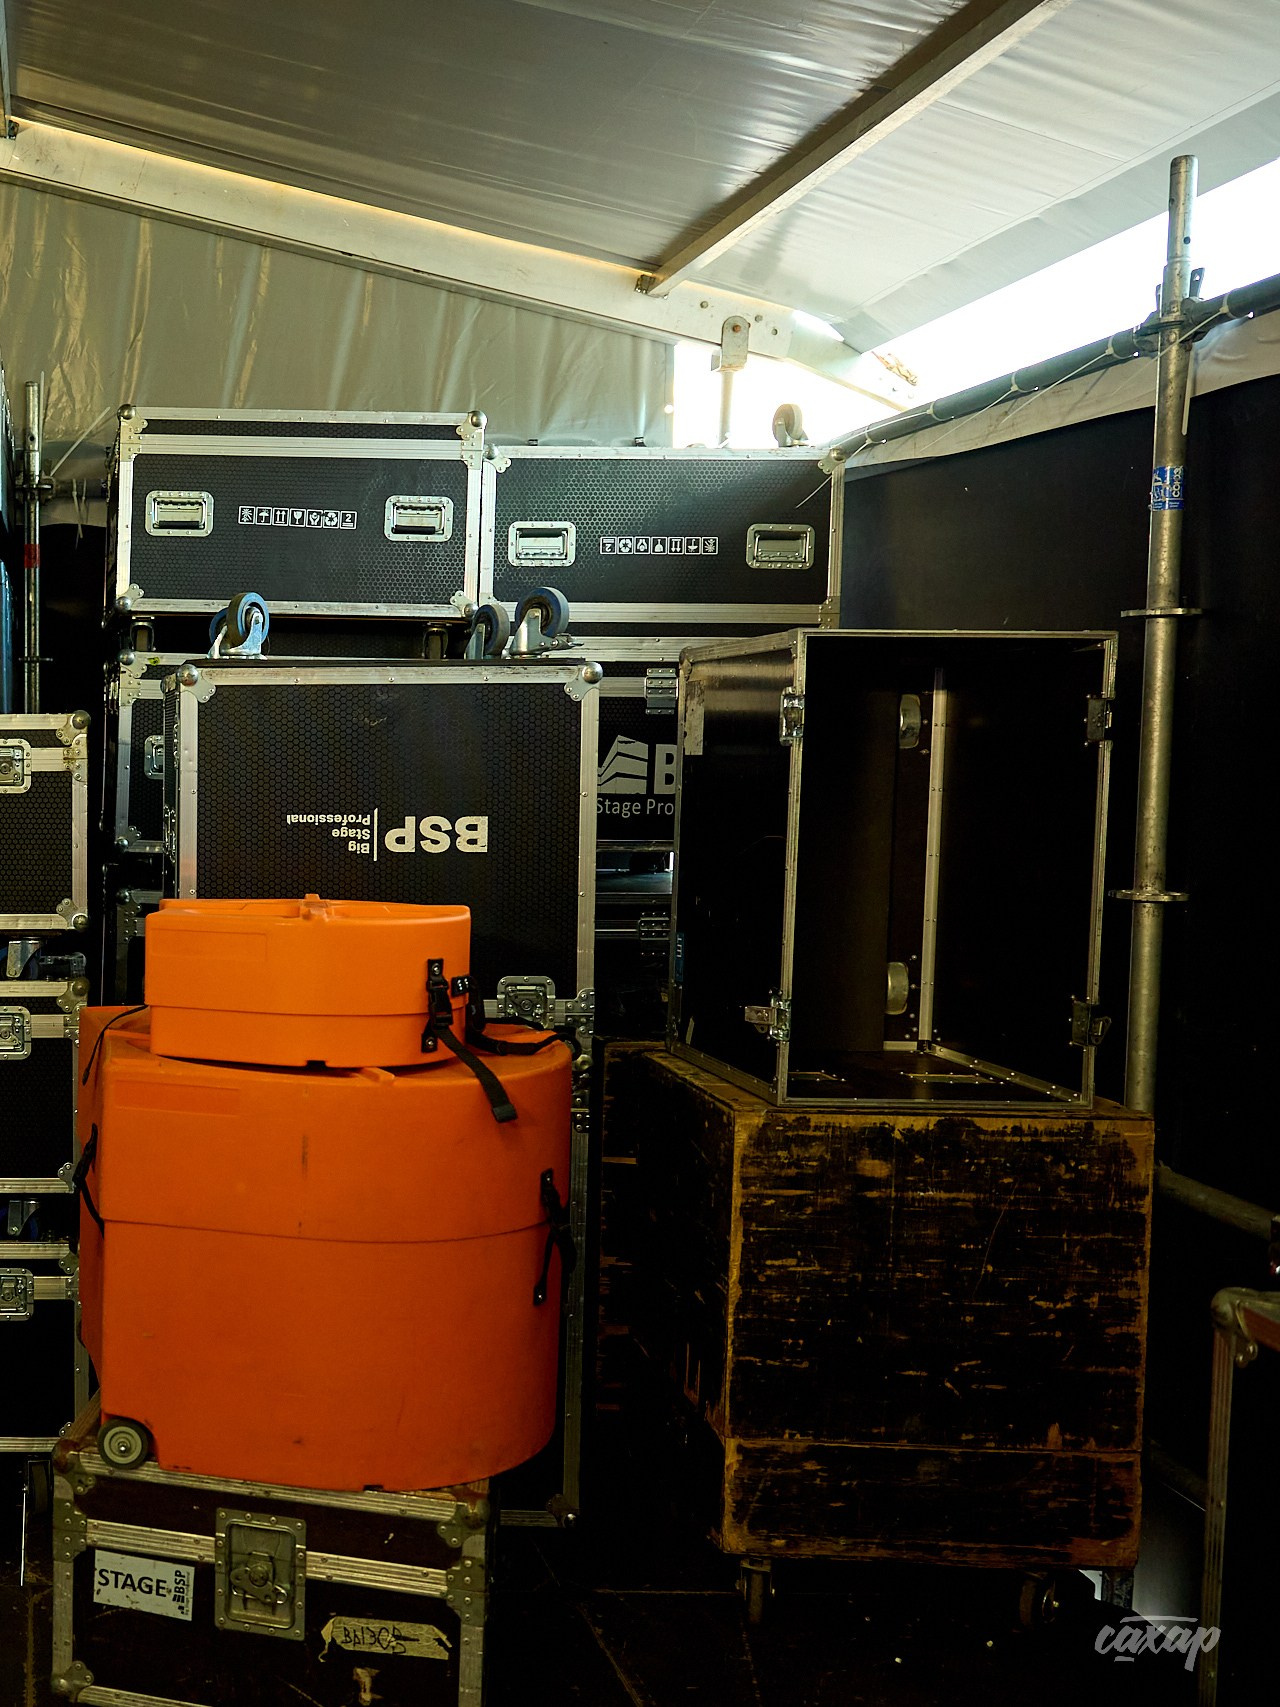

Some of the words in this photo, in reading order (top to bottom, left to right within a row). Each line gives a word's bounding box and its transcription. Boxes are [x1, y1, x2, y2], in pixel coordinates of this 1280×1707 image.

[597, 798, 642, 819] Stage
[286, 814, 371, 826] Professional
[331, 827, 371, 841] Stage
[384, 815, 489, 854] BSP
[347, 841, 371, 855] Big
[98, 1568, 167, 1598] STAGE
[174, 1570, 186, 1595] BSP
